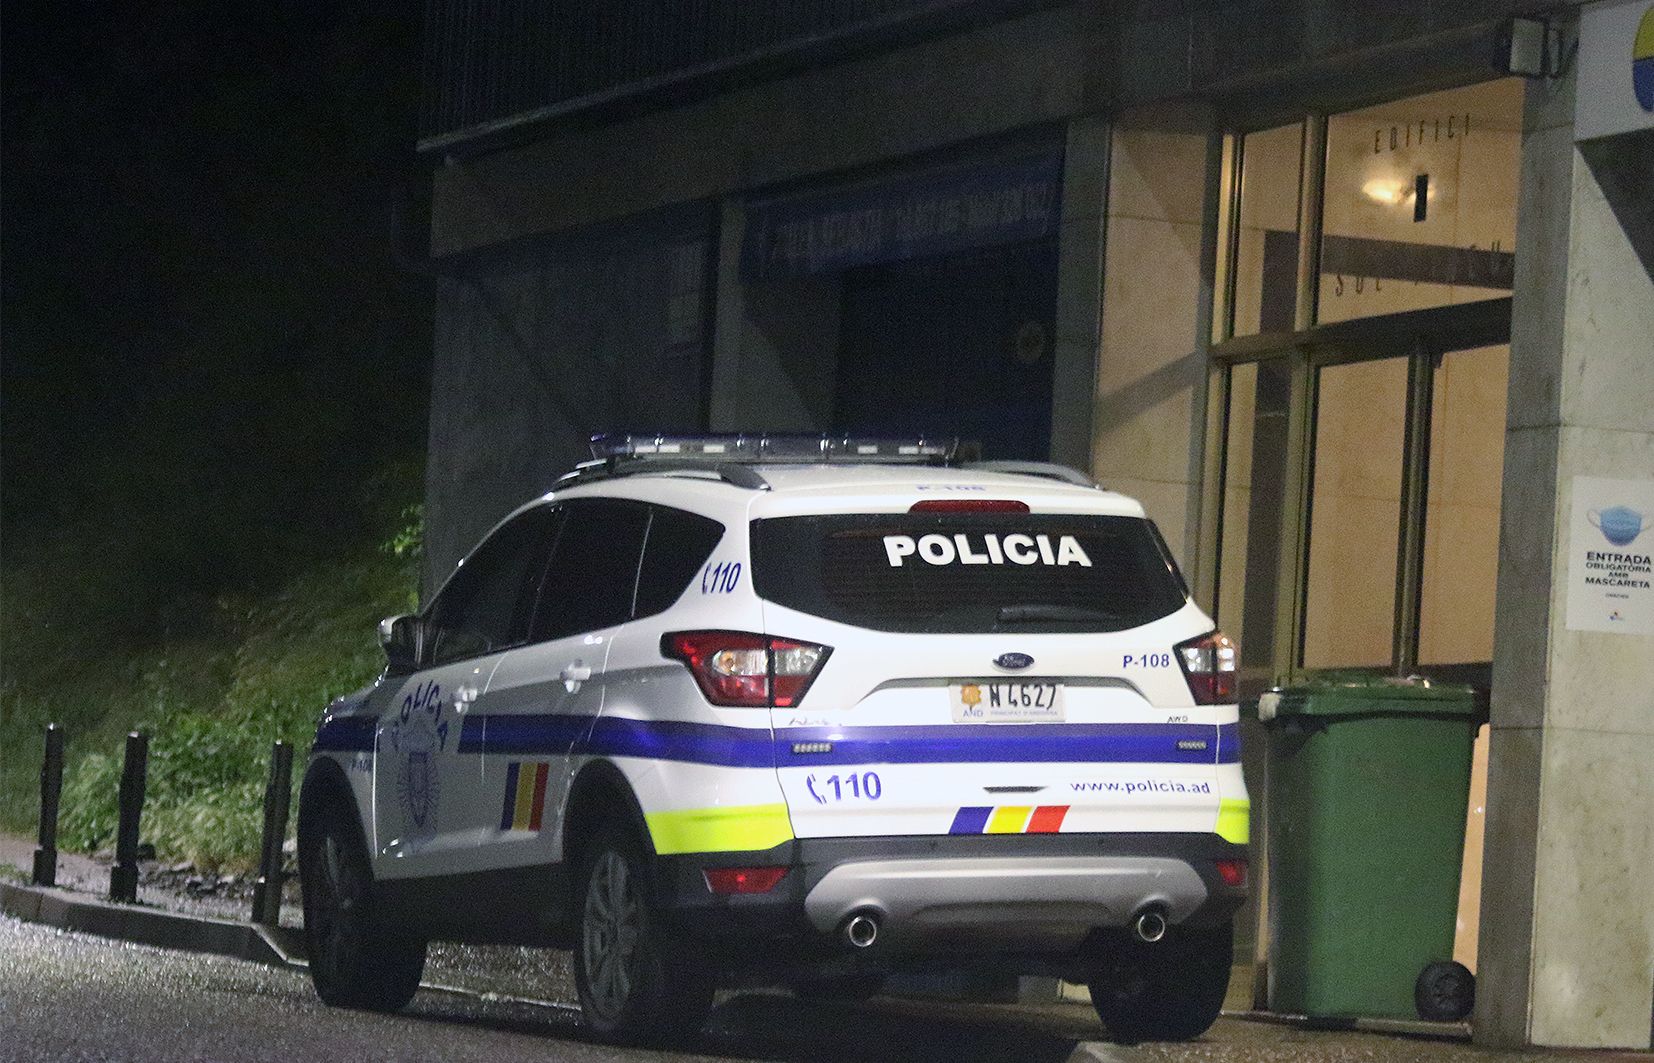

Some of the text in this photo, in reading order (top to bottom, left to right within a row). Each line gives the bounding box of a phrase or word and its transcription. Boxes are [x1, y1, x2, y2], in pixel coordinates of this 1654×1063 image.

[1375, 114, 1469, 154] EDIFICI
[883, 534, 1092, 568] POLICIA
[1586, 552, 1652, 565] ENTRADA
[711, 562, 741, 594] 110
[1585, 577, 1650, 588] MASCARETA
[1123, 654, 1170, 668] P-108
[1167, 715, 1188, 724] AWD
[827, 771, 882, 801] 110
[1070, 780, 1211, 795] www.policia.ad
